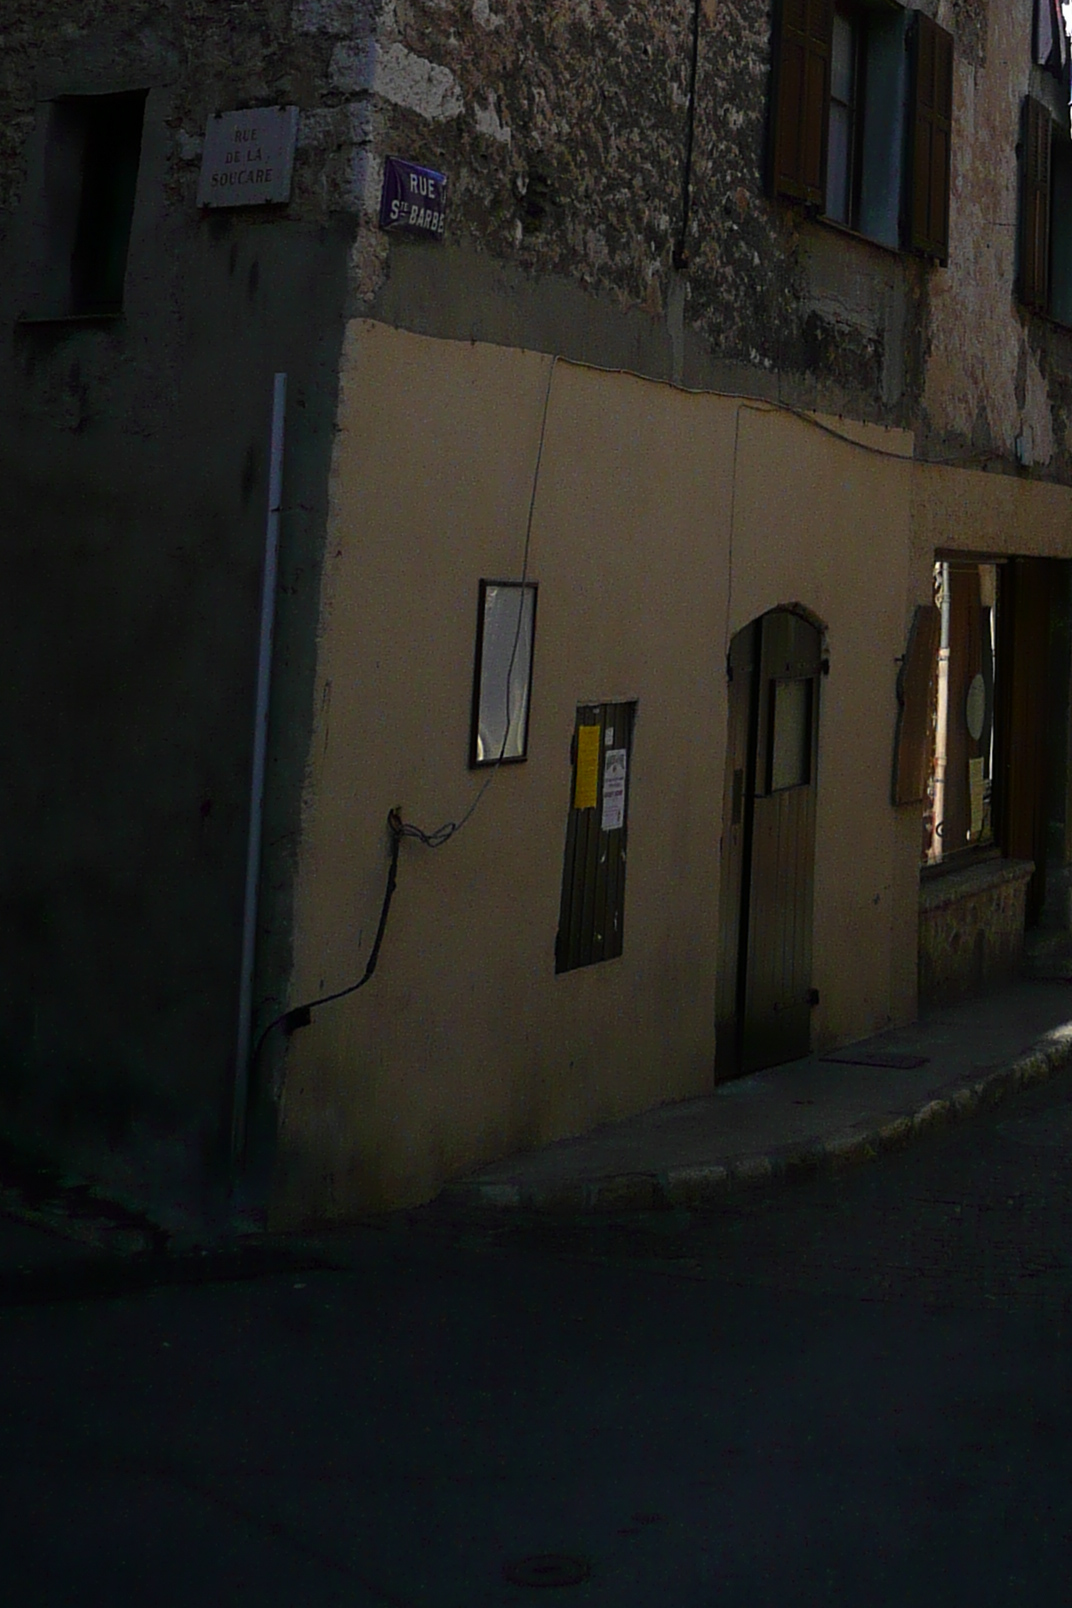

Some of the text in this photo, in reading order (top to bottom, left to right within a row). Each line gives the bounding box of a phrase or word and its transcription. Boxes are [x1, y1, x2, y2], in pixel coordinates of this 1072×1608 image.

[234, 129, 258, 143] RUE
[225, 147, 262, 164] DE LA
[210, 169, 273, 187] SOUCARE
[409, 173, 436, 199] RUE
[408, 204, 445, 233] BARBE
